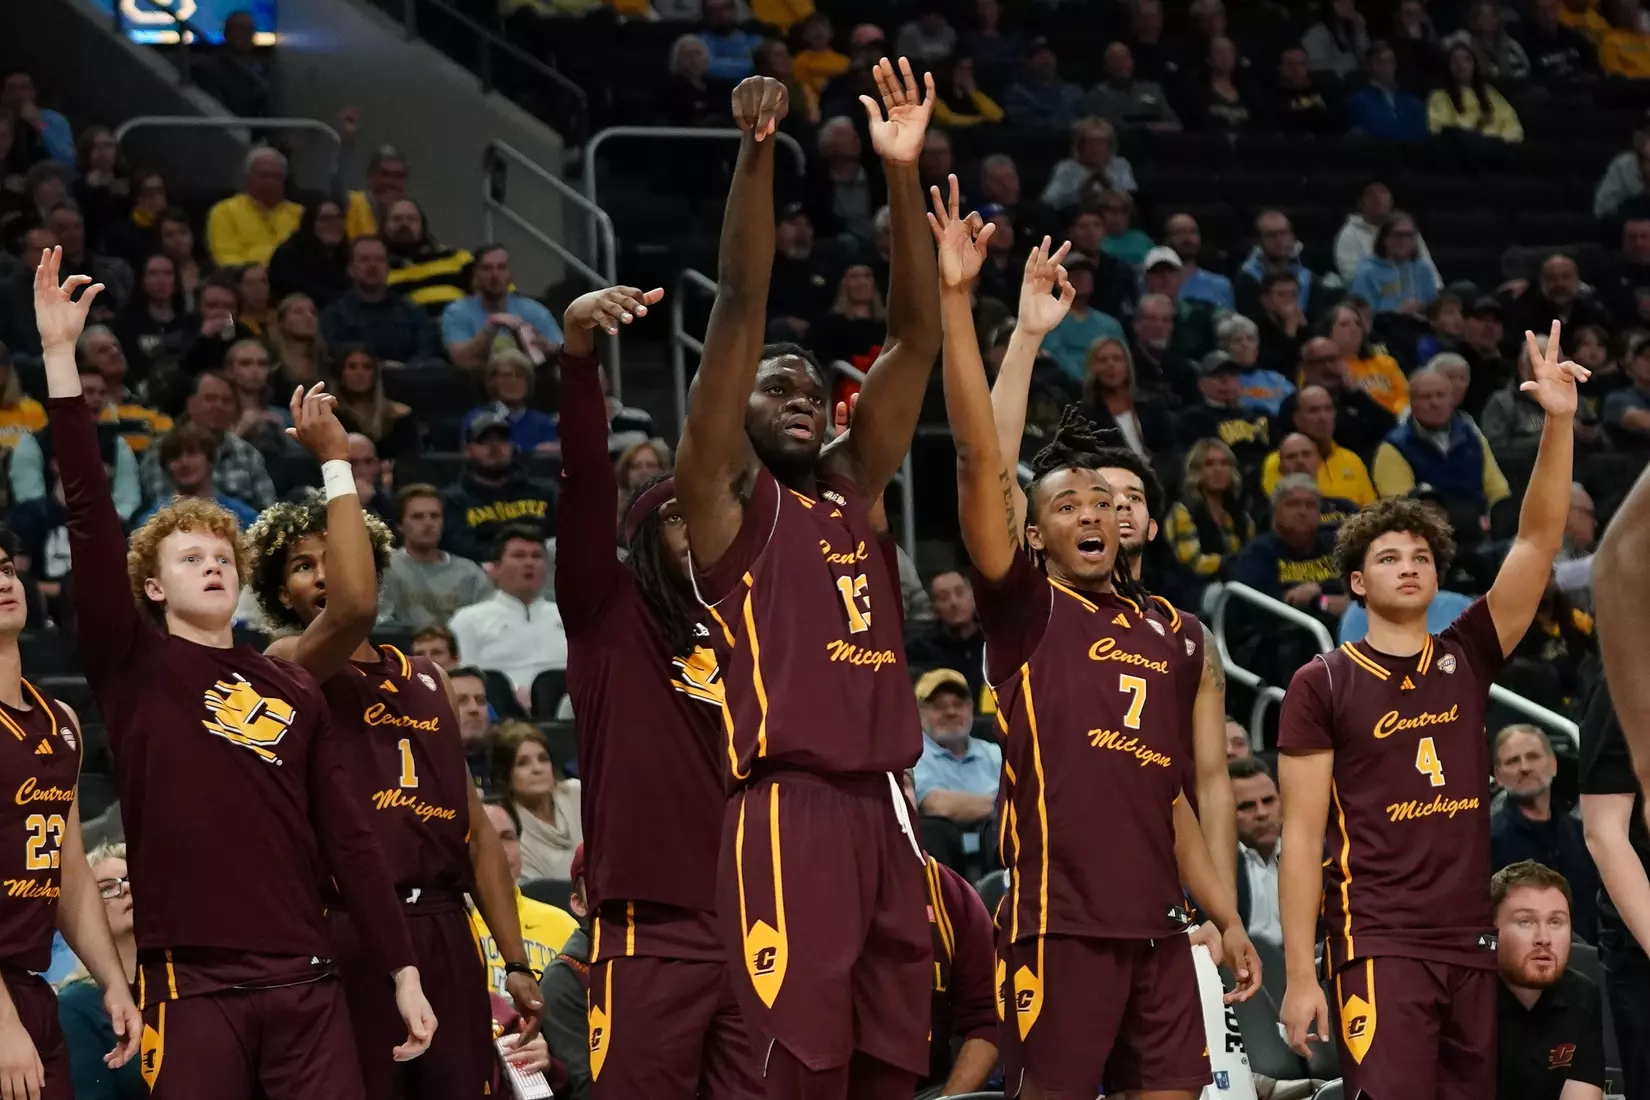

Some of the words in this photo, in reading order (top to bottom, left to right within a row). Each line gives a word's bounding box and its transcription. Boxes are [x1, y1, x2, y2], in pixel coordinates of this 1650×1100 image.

[1089, 637, 1169, 674] Central
[1119, 673, 1147, 729] 7
[1374, 704, 1459, 739] Central
[398, 738, 419, 788] 1
[1415, 737, 1445, 787] 4
[1386, 794, 1480, 823] Michigan
